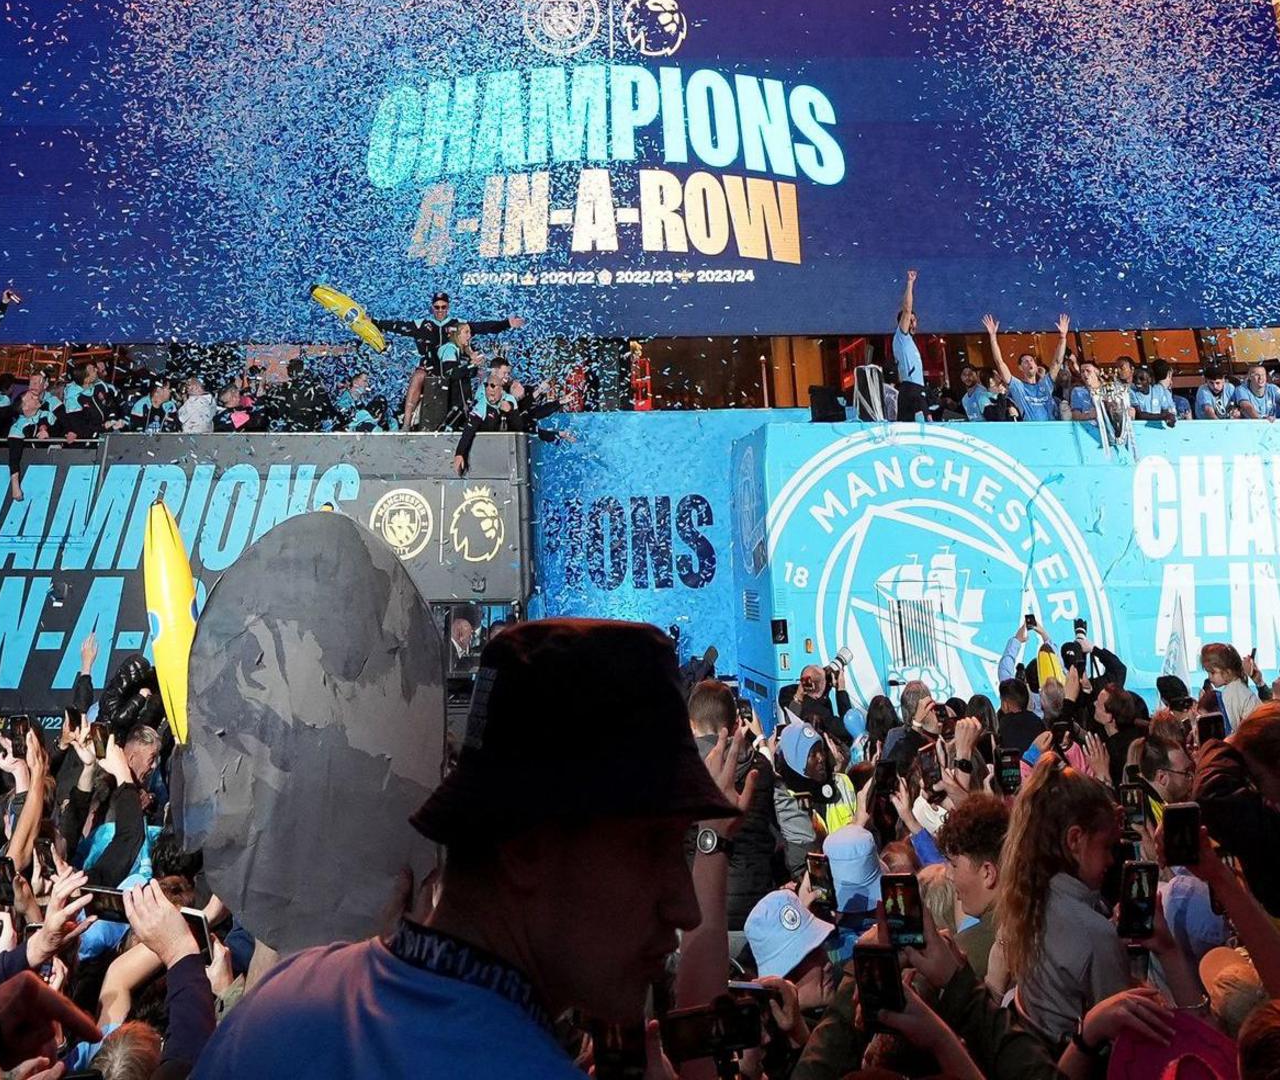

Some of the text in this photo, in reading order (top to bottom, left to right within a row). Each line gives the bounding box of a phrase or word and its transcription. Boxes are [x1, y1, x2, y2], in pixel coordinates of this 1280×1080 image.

[367, 63, 846, 188] CHAMPIONS
[409, 168, 802, 266] 4-IN-A-ROW
[540, 270, 596, 285] 2021/22
[616, 270, 674, 285] 2022/23
[696, 269, 755, 284] 2023/24
[783, 560, 810, 589] 18
[809, 452, 1079, 623] MANCHESTER
